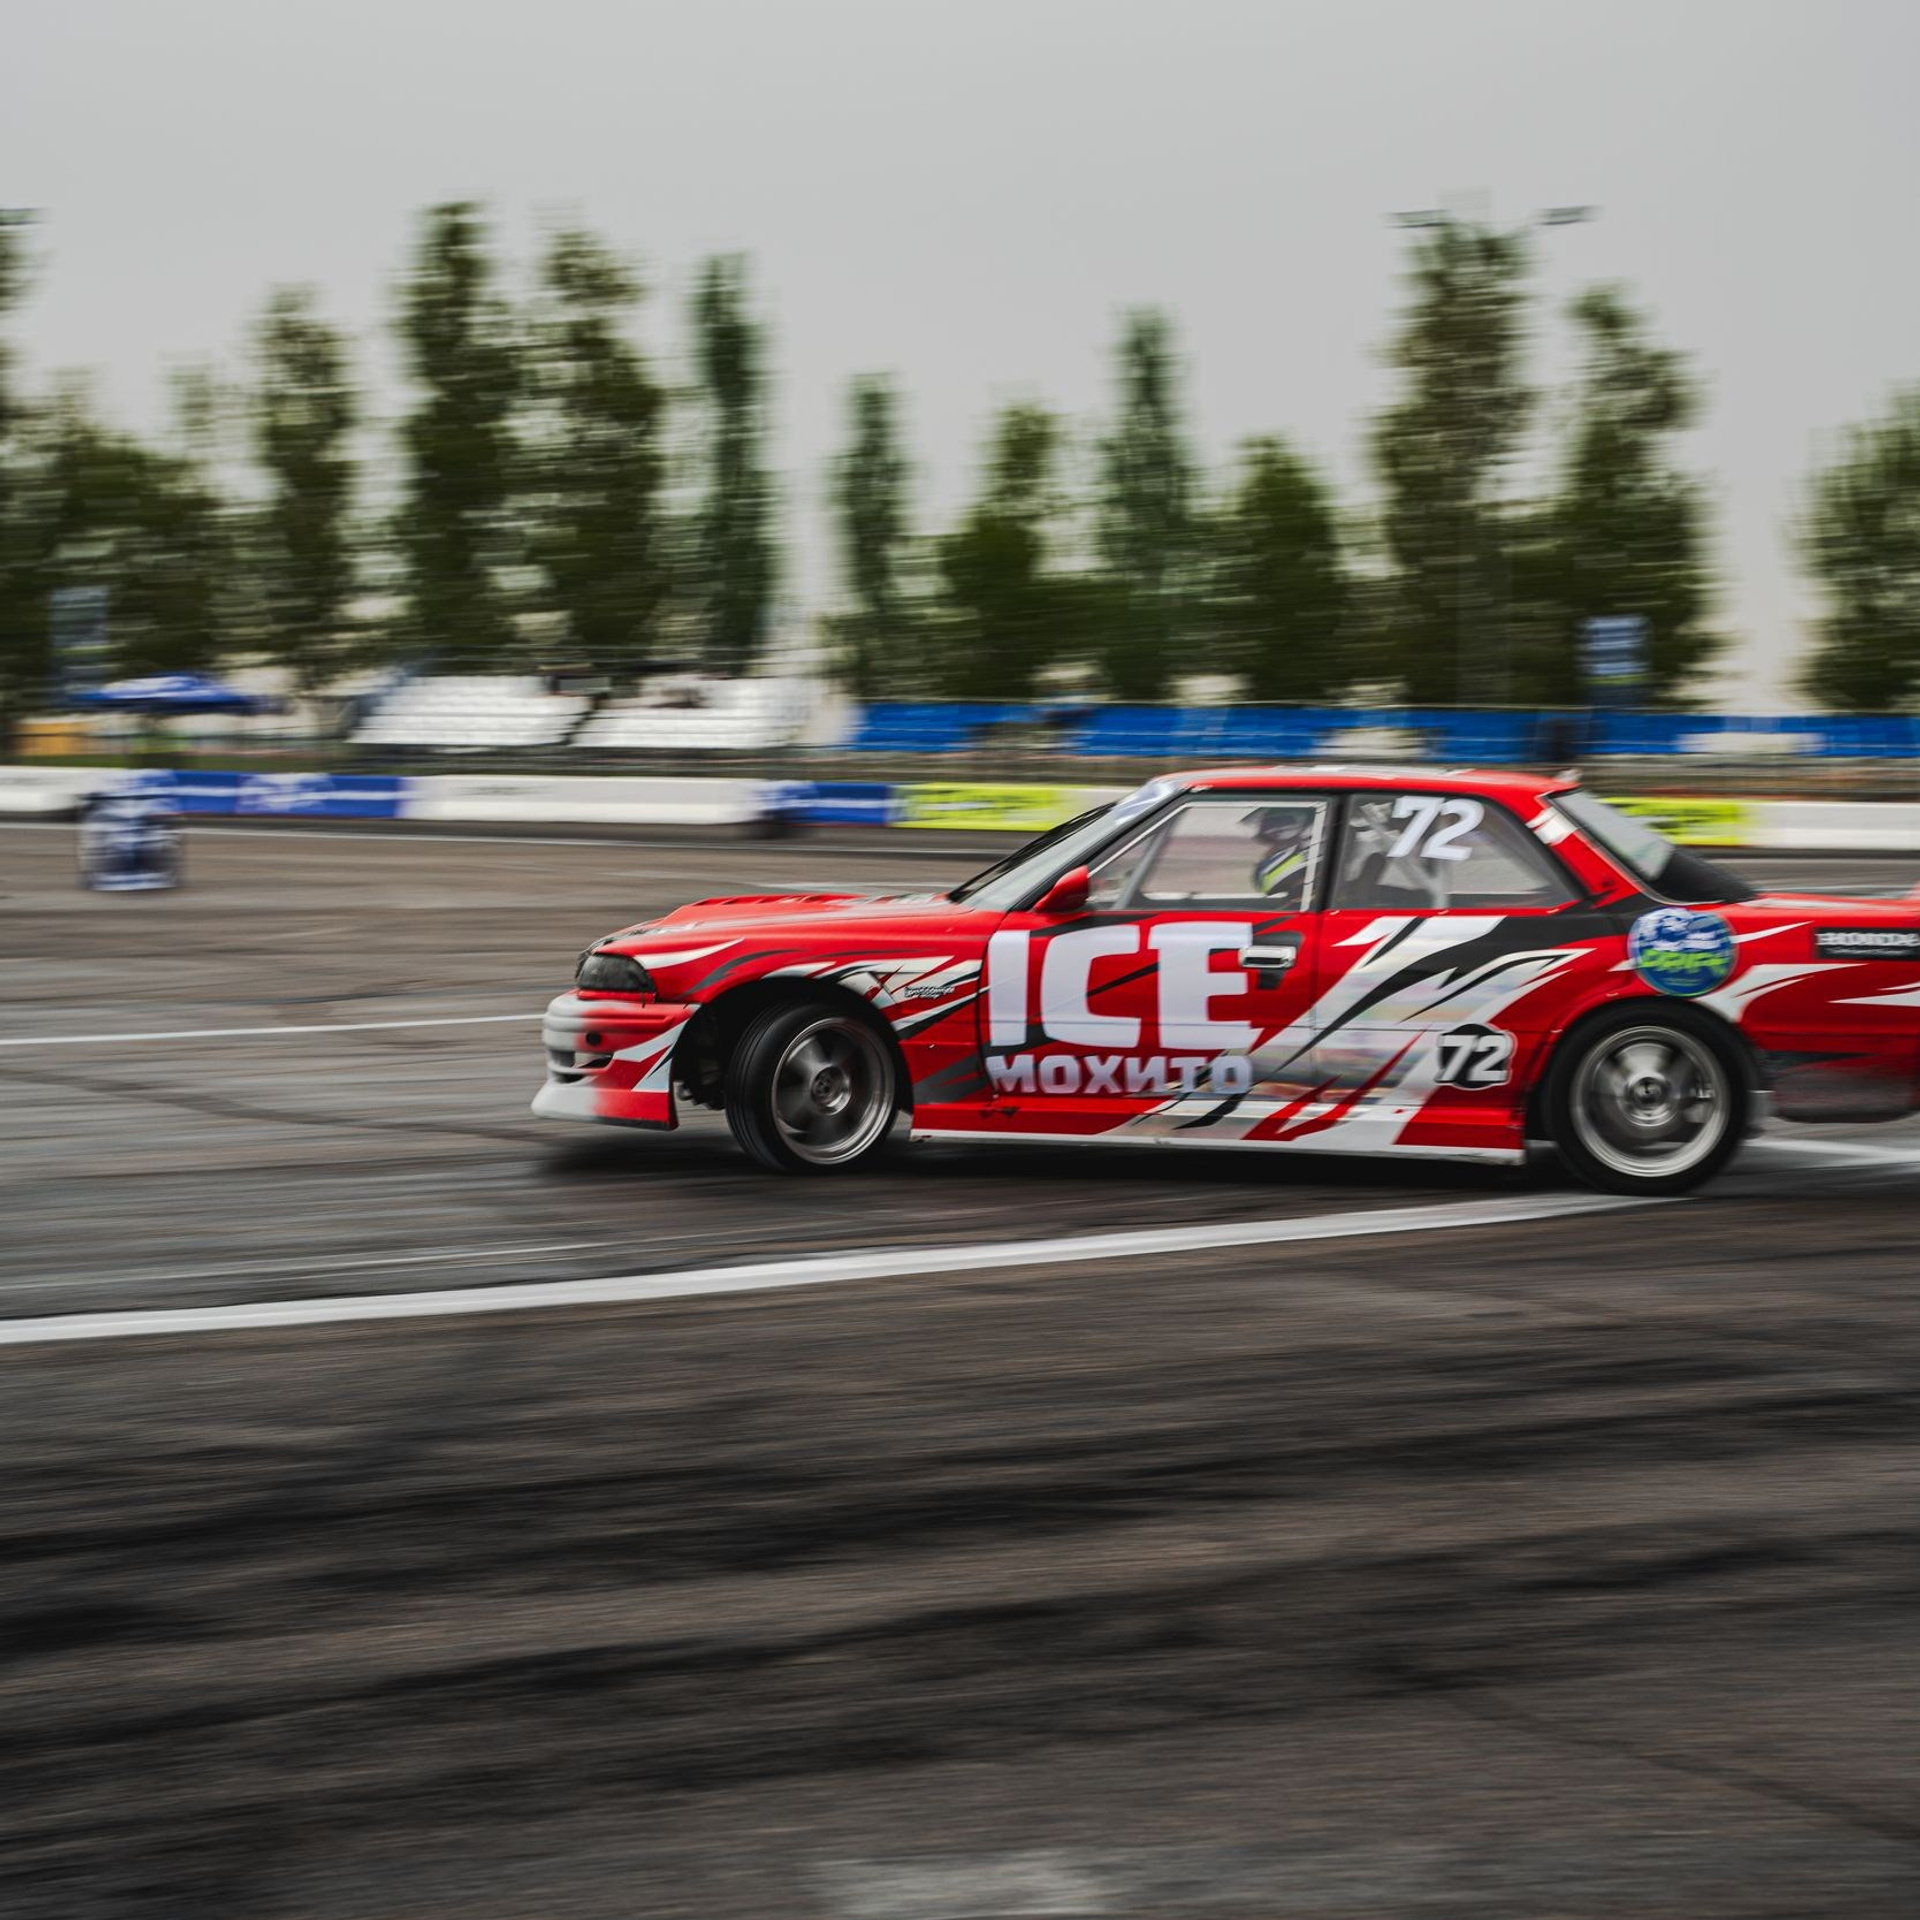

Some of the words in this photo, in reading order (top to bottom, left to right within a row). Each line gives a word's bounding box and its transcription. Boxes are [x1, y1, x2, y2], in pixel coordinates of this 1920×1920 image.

[1385, 795, 1485, 861] 72
[987, 921, 1253, 1050] ICE
[985, 1054, 1253, 1095] МОХИТО
[1437, 1034, 1513, 1082] 72
